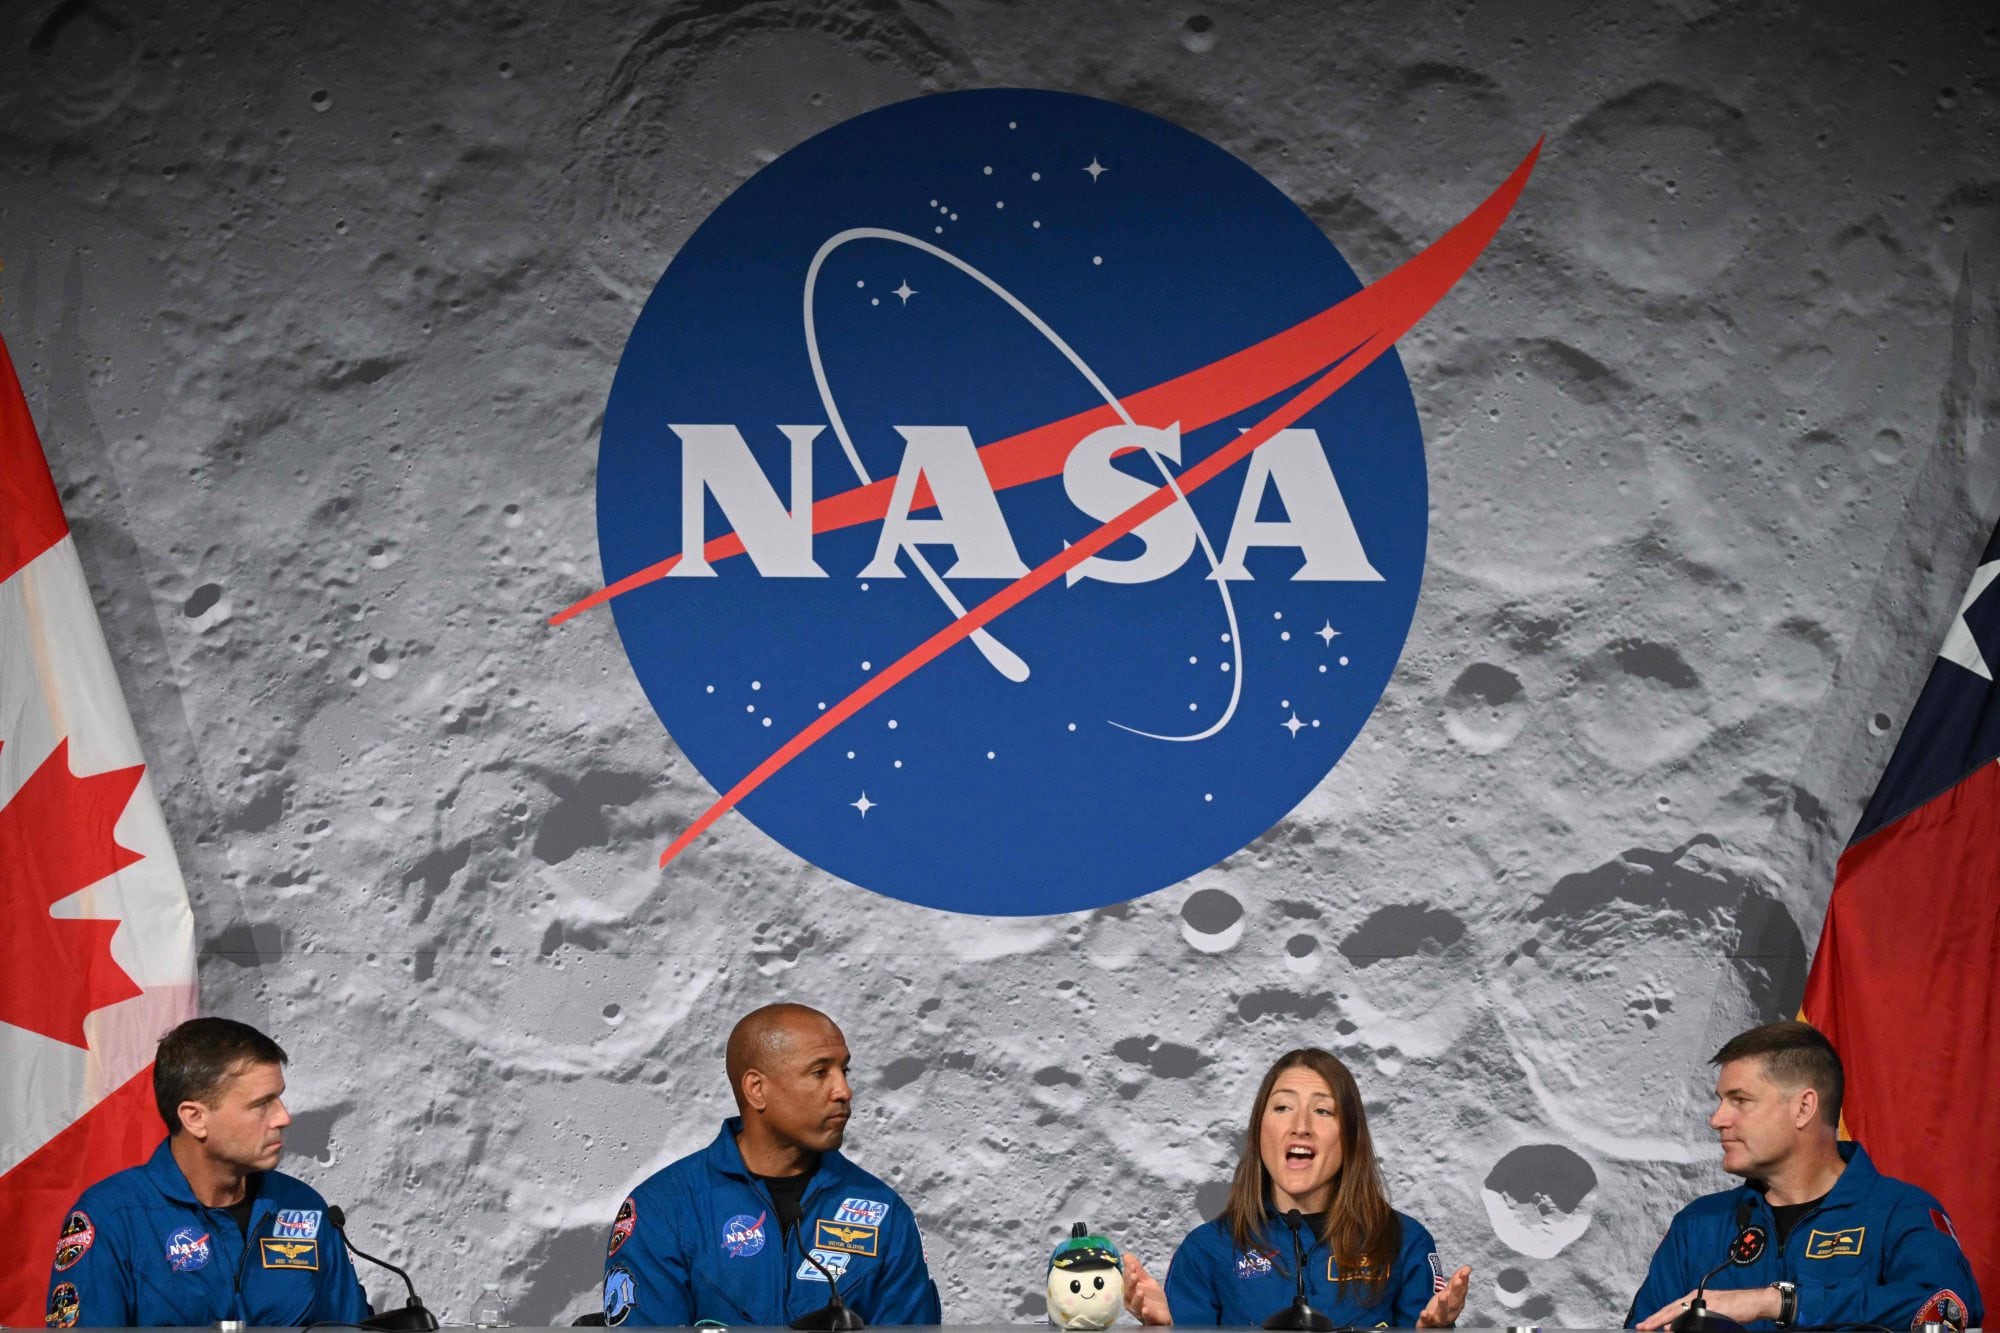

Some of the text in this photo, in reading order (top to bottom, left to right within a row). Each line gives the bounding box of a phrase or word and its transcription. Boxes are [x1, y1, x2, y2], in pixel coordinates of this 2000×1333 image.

[664, 419, 1386, 588] NASA
[836, 1199, 886, 1224] 100
[276, 1211, 319, 1237] 100
[726, 1228, 763, 1243] NASA
[169, 1240, 208, 1256] NASA
[1238, 1255, 1272, 1270] NASA
